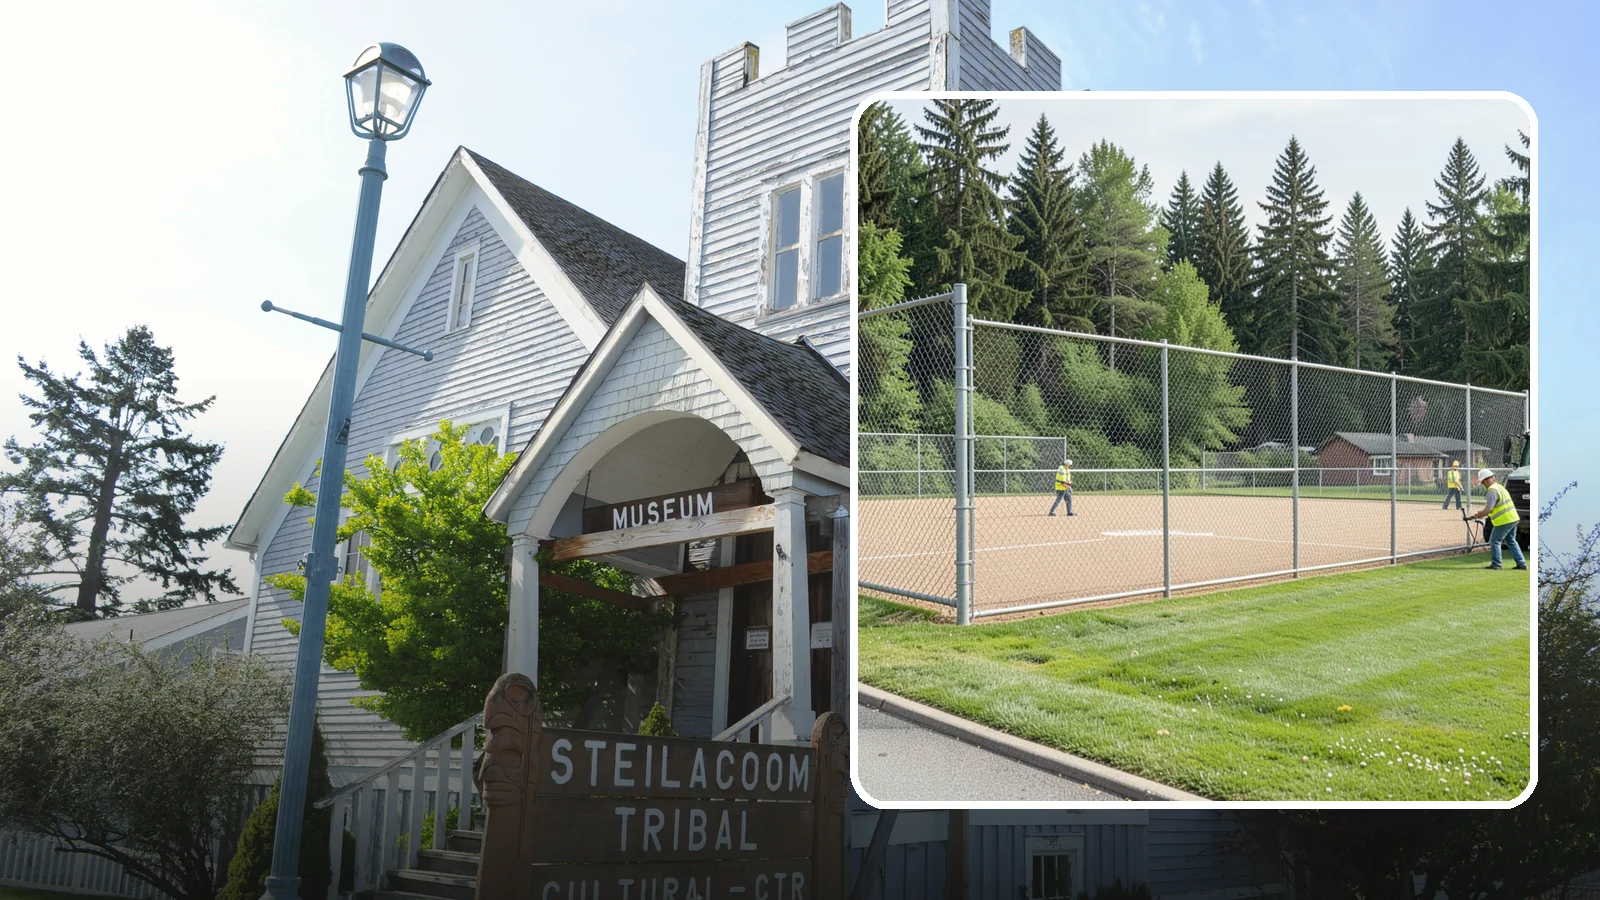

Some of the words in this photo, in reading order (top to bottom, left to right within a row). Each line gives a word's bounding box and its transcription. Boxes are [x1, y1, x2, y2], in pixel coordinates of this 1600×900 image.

[613, 491, 713, 531] MUSEUM
[550, 738, 810, 792] STEILACOOM
[614, 806, 758, 852] TRIBAL
